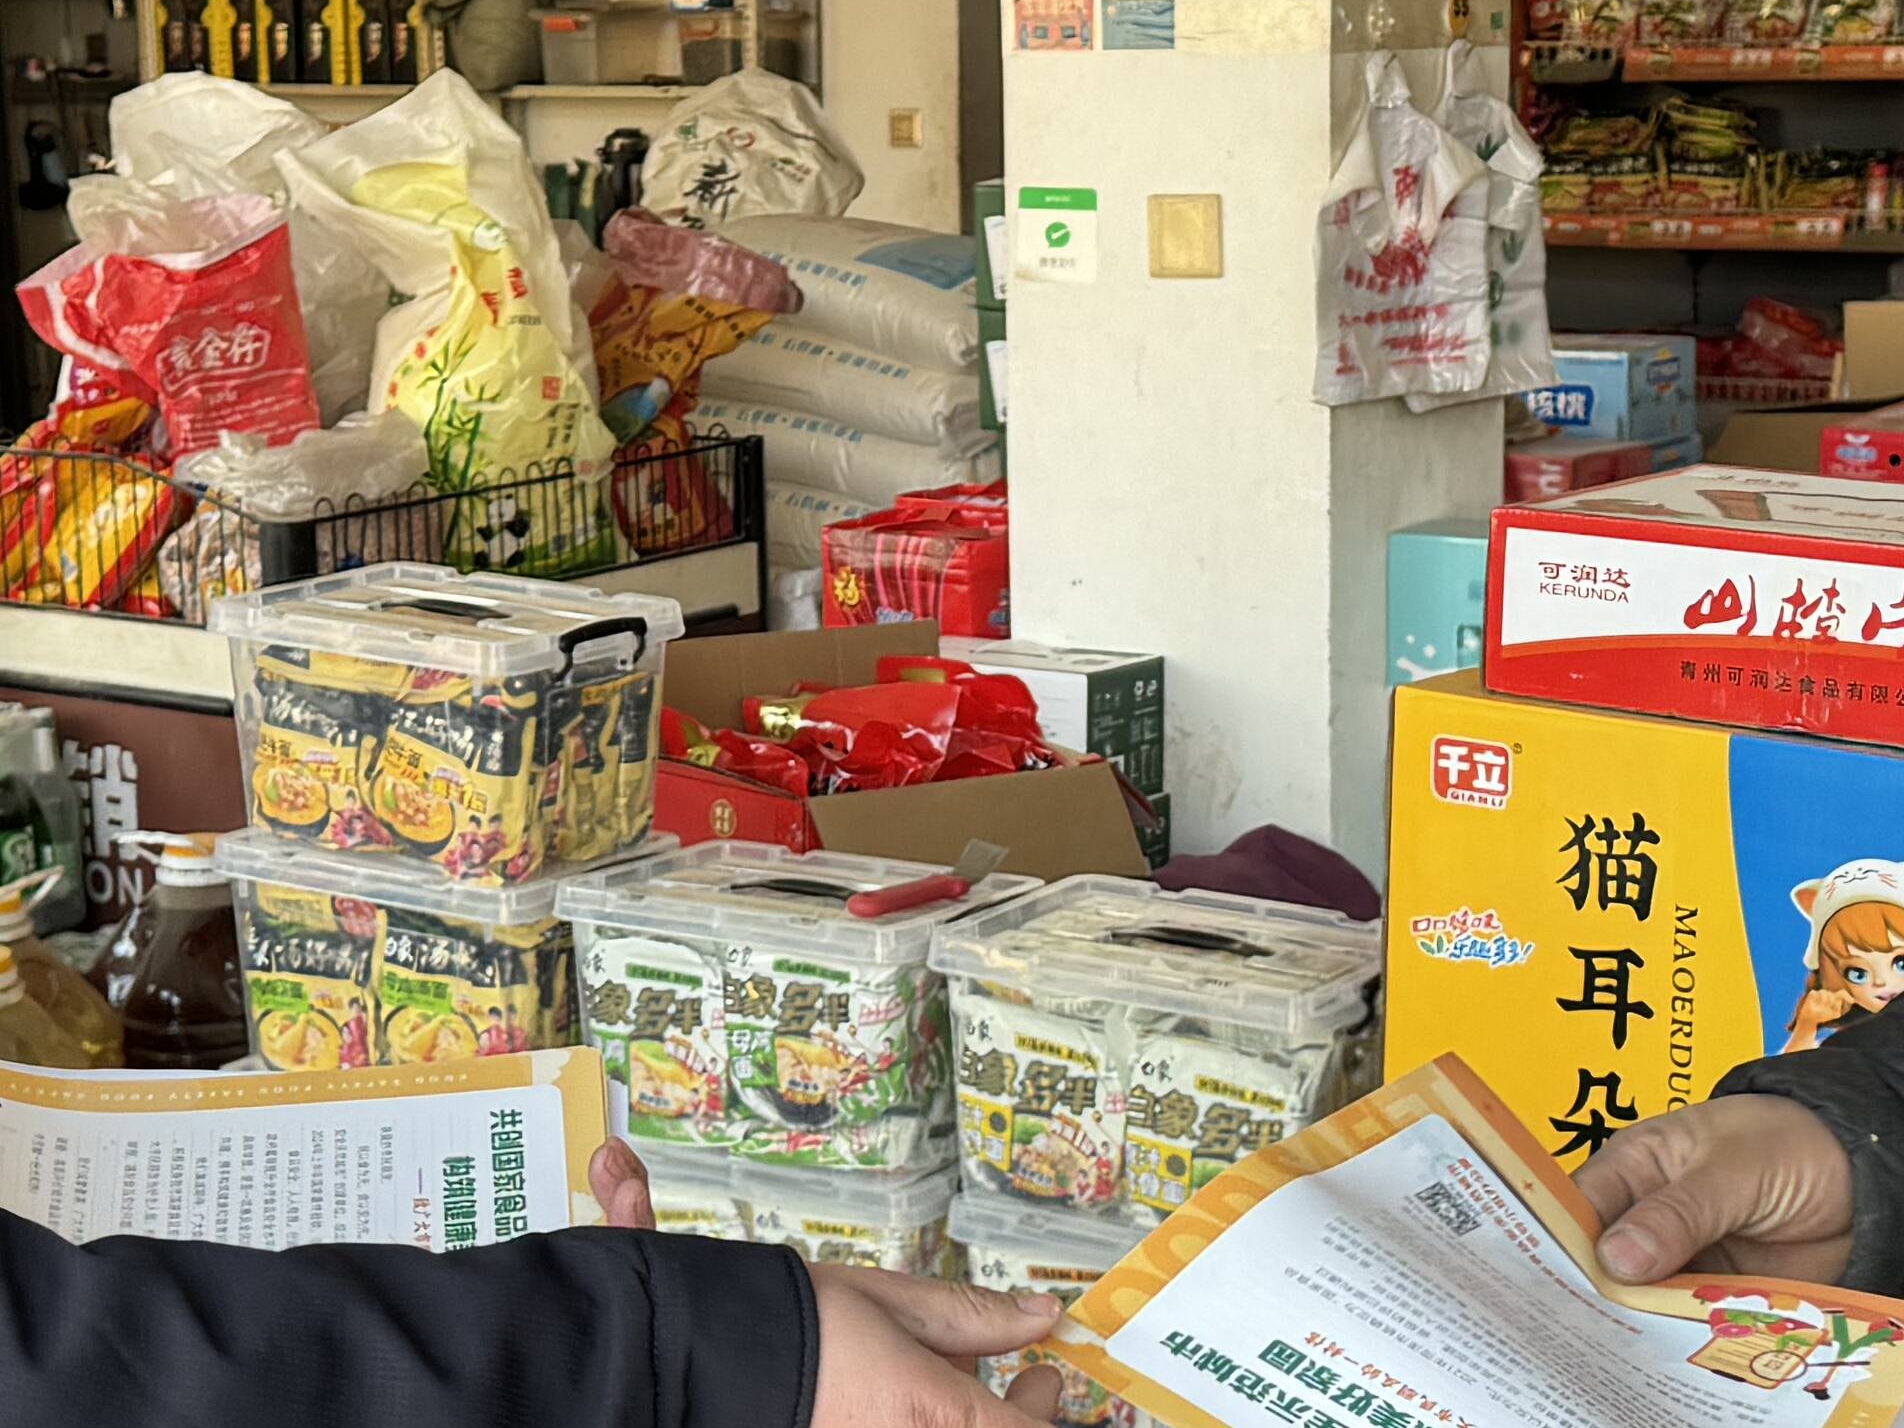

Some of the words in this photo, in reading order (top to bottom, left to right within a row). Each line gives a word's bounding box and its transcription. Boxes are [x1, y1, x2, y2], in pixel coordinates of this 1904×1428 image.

[1538, 561, 1632, 590] 可润达
[1539, 582, 1630, 605] KERUNDA
[1438, 744, 1506, 792] 千立
[1450, 790, 1504, 808] QIANLI
[1547, 812, 1660, 1157] 猫耳朵
[490, 1109, 528, 1242] 共创国家食品
